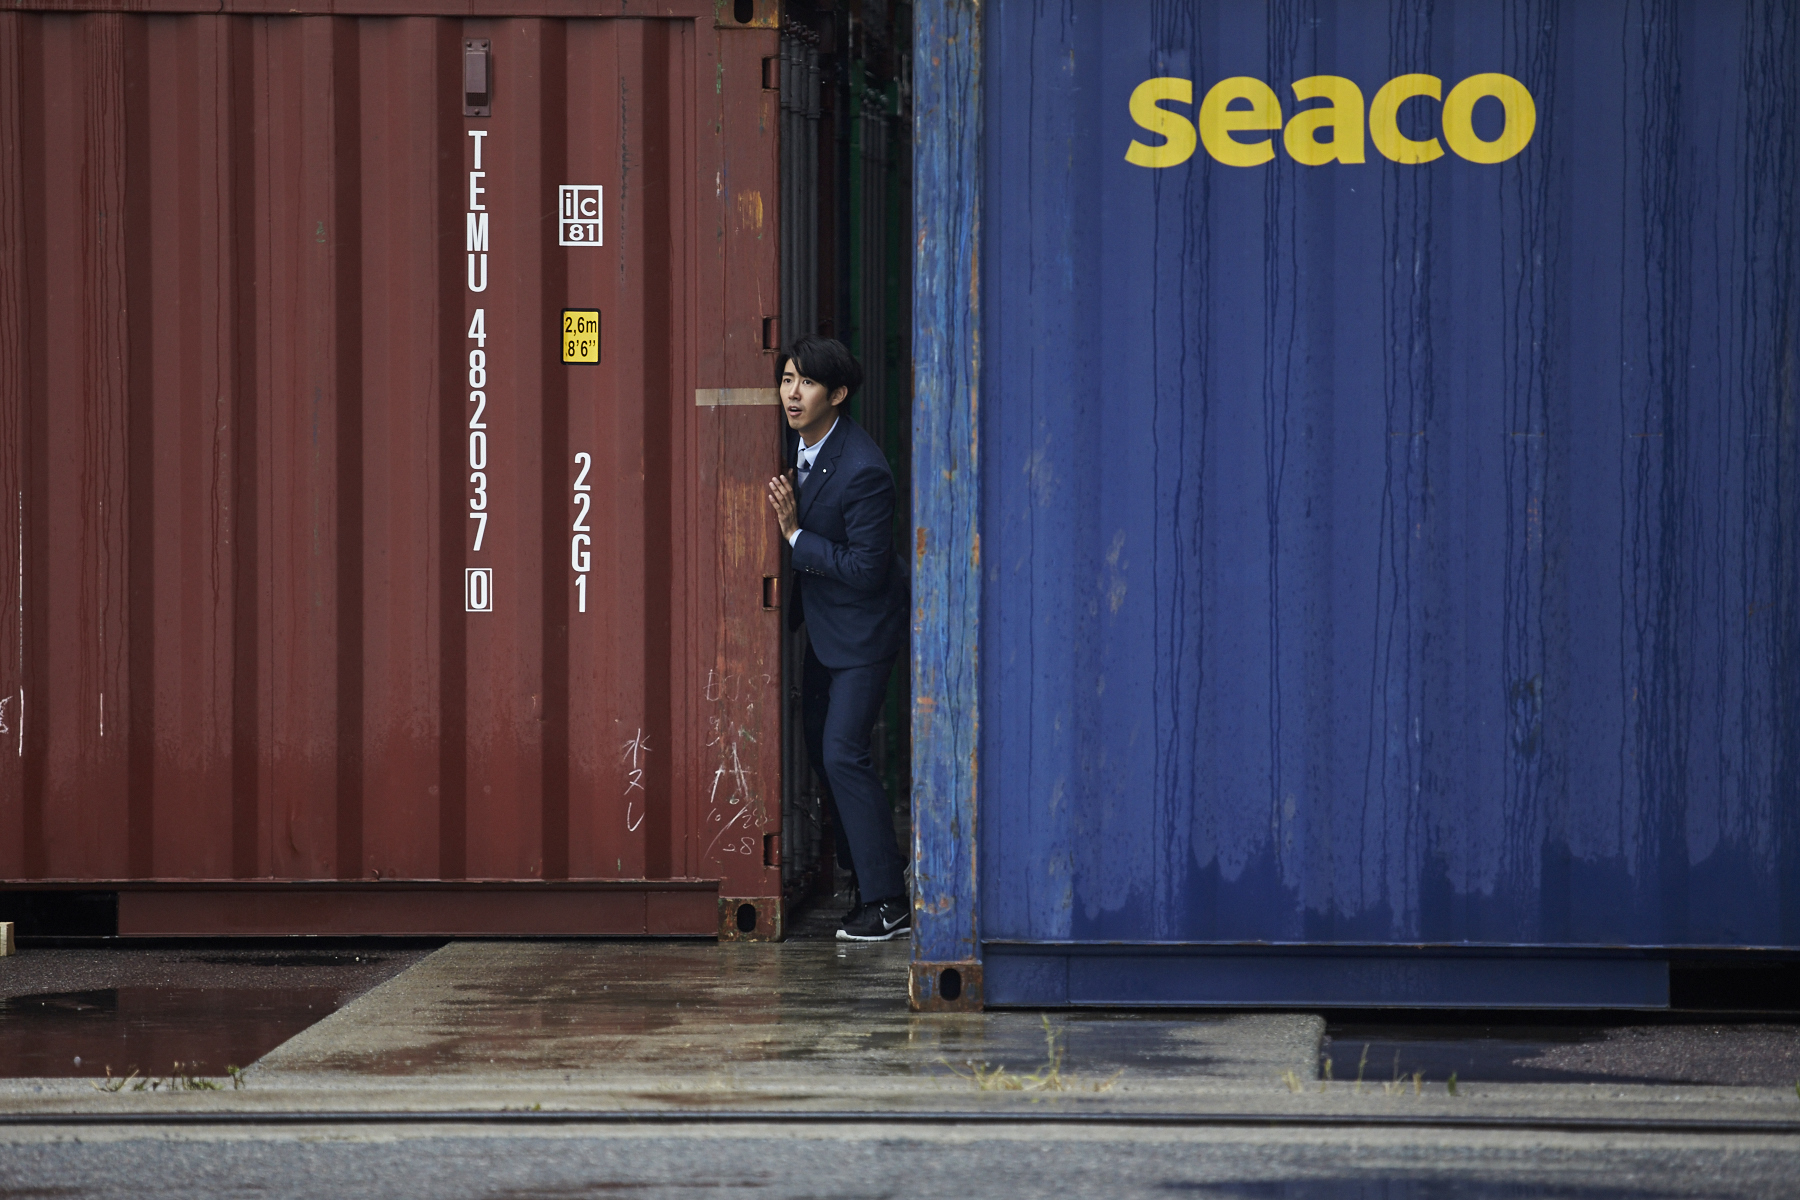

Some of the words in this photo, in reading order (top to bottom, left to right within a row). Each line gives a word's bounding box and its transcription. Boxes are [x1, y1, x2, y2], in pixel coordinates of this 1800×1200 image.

[1124, 72, 1537, 169] seaco
[466, 130, 489, 293] TEMU
[568, 223, 595, 241] 81
[565, 316, 597, 337] 2,6m
[467, 308, 488, 551] 482037
[571, 452, 592, 613] 22G1
[470, 570, 488, 610] 0
